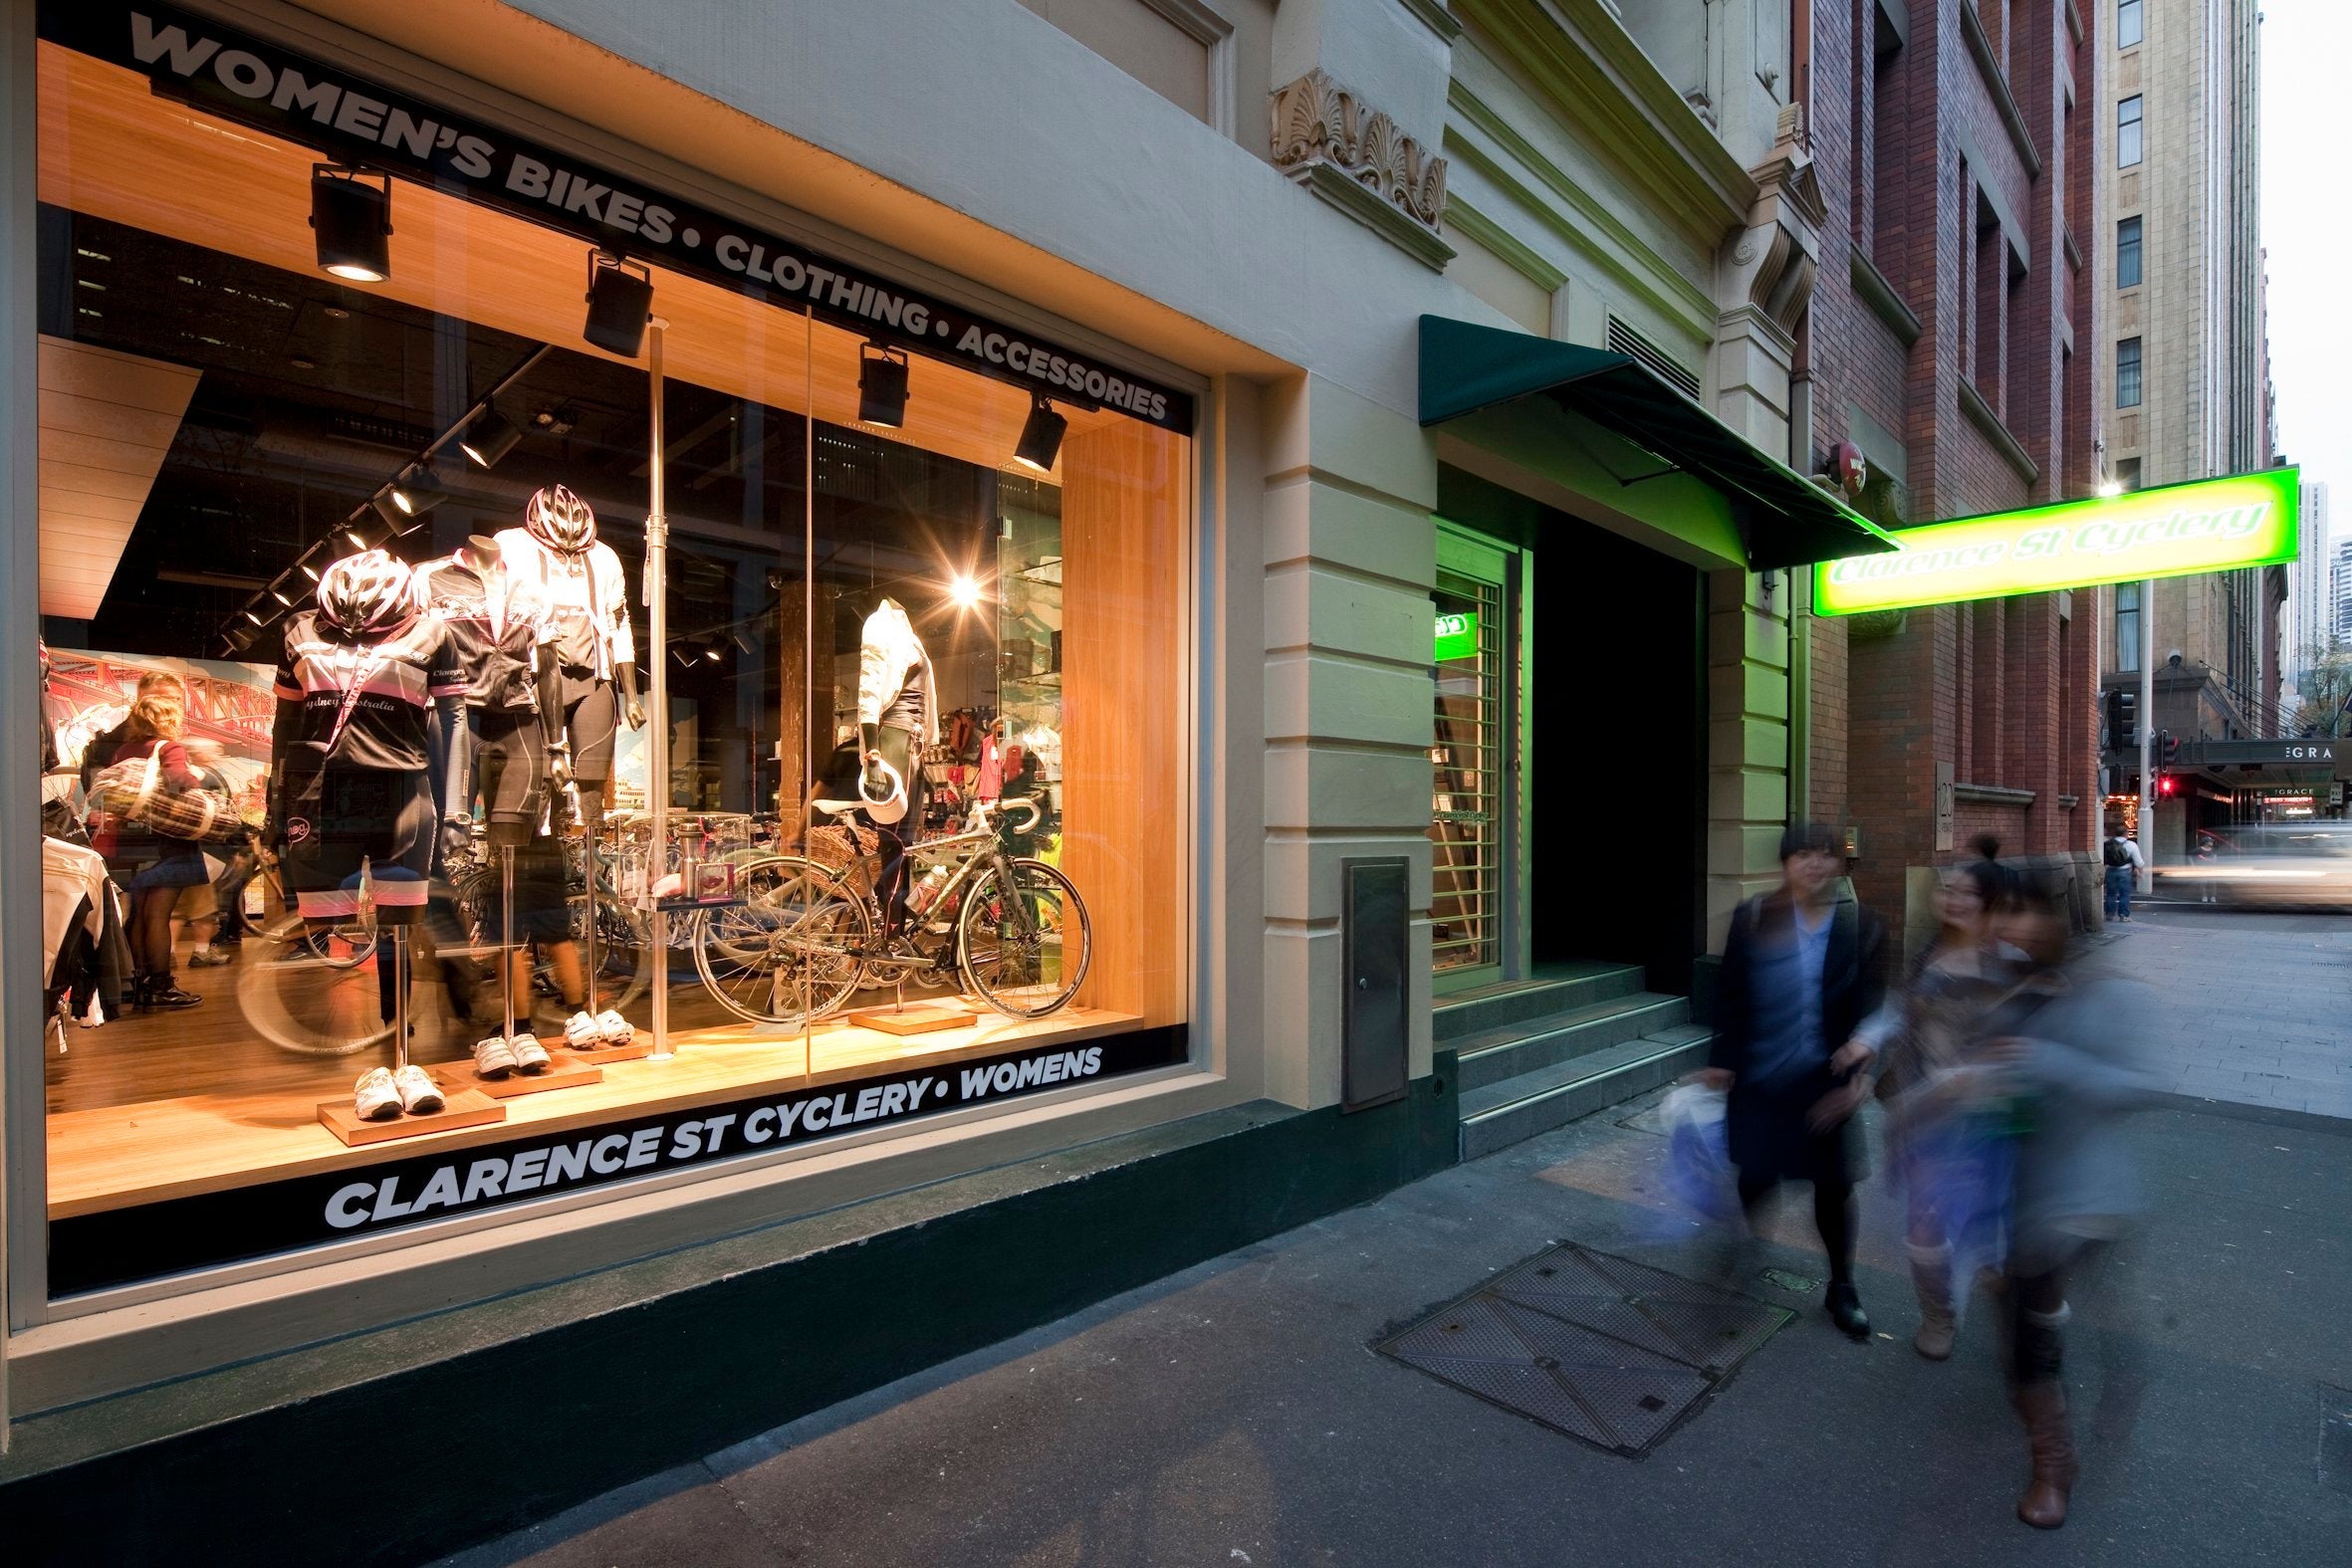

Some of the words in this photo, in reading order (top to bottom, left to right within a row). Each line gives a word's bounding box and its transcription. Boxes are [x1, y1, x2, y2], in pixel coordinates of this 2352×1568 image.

[130, 12, 495, 179] WOMEN'S
[505, 152, 678, 244] BIKES
[715, 235, 930, 336] CLOTHING
[956, 324, 1167, 420] ACCESSORIES
[1832, 540, 2003, 585] Clarence
[2015, 527, 2064, 560] St
[2074, 503, 2269, 553] Cyclery
[306, 696, 340, 710] ydney
[2292, 747, 2332, 759] GRA
[325, 1126, 666, 1230] CLARENCE
[668, 1114, 737, 1159] ST
[743, 1076, 933, 1145] CYCLERY
[960, 1046, 1102, 1101] WOMENS
